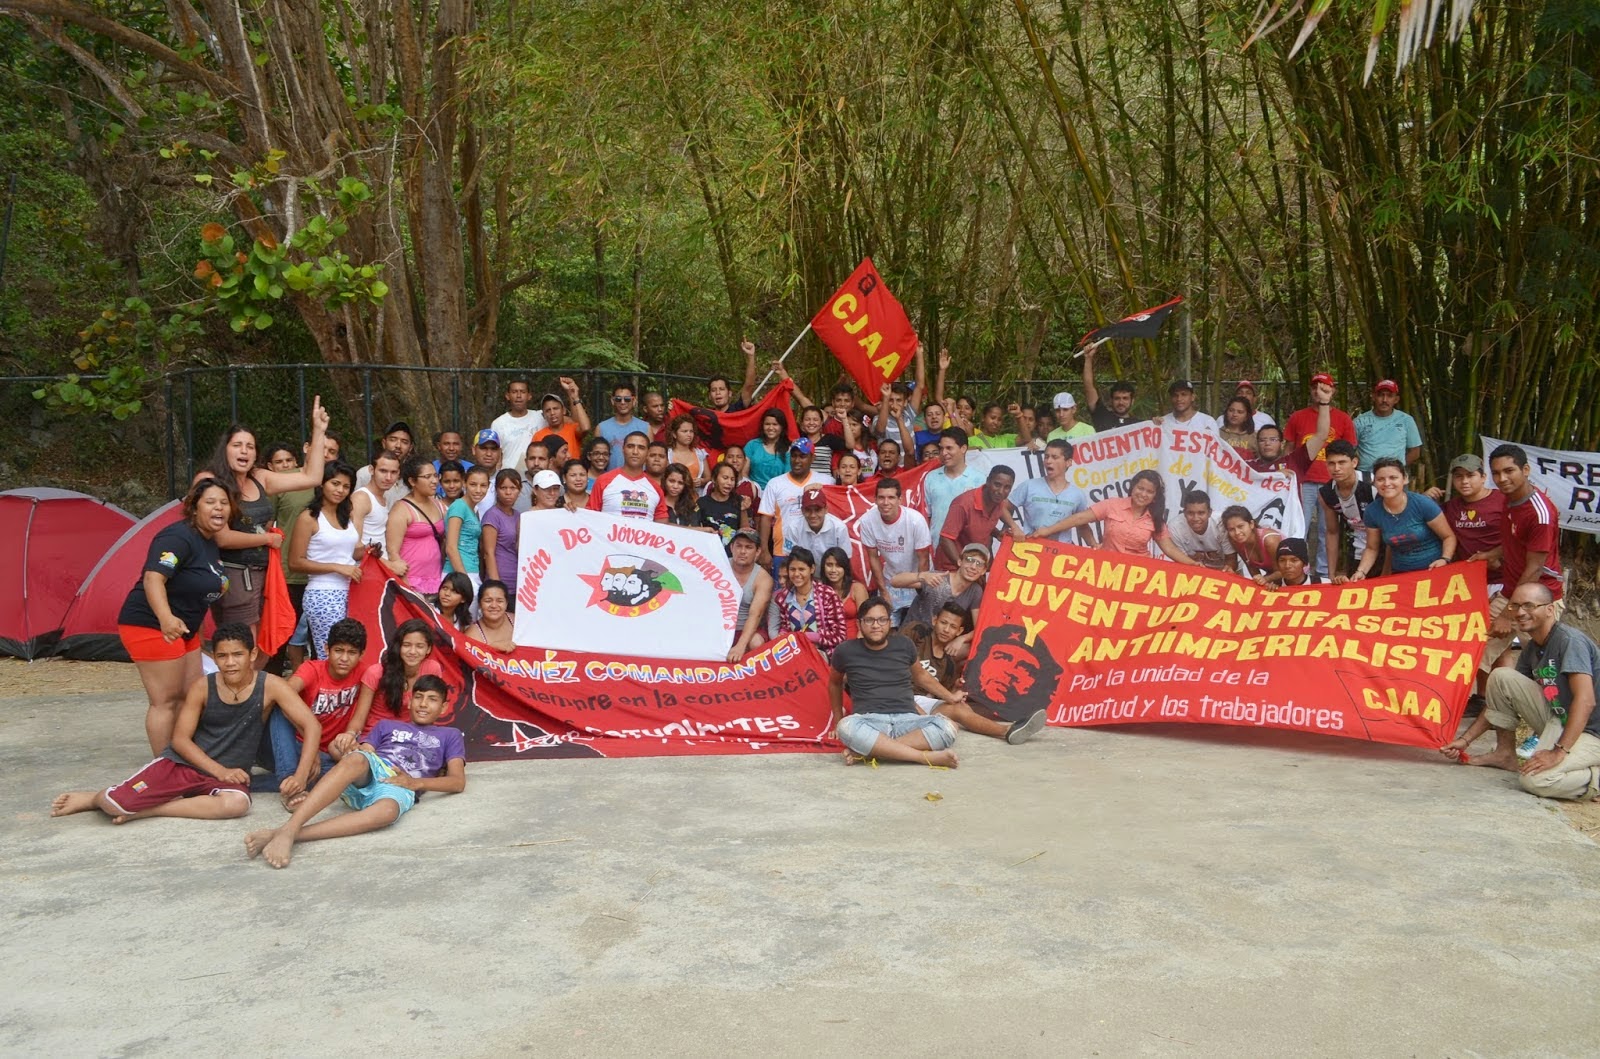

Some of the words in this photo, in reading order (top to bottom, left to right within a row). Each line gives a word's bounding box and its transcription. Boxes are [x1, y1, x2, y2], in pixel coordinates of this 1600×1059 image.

[832, 293, 900, 379] CJAA
[1170, 429, 1254, 485] ESTADAL
[1051, 554, 1322, 607] CAMPAMENTO
[1337, 584, 1399, 611] DE
[1413, 573, 1472, 608] LA
[996, 578, 1200, 631] JUVENTUD
[1204, 609, 1488, 642] ANTIFASCISTA
[585, 633, 801, 684] COMANDANTE!
[1021, 615, 1048, 648] Y
[1068, 631, 1474, 686] ANTIIMPERIALISTA
[618, 695, 647, 708] en
[653, 689, 678, 708] la
[685, 668, 820, 706] conciencia
[1069, 673, 1102, 693] Por
[1106, 668, 1125, 687] la
[1130, 664, 1204, 683] unidad
[1209, 669, 1242, 685] de
[1246, 669, 1270, 686] la
[1160, 695, 1189, 717] los
[1362, 687, 1442, 724] CJAA
